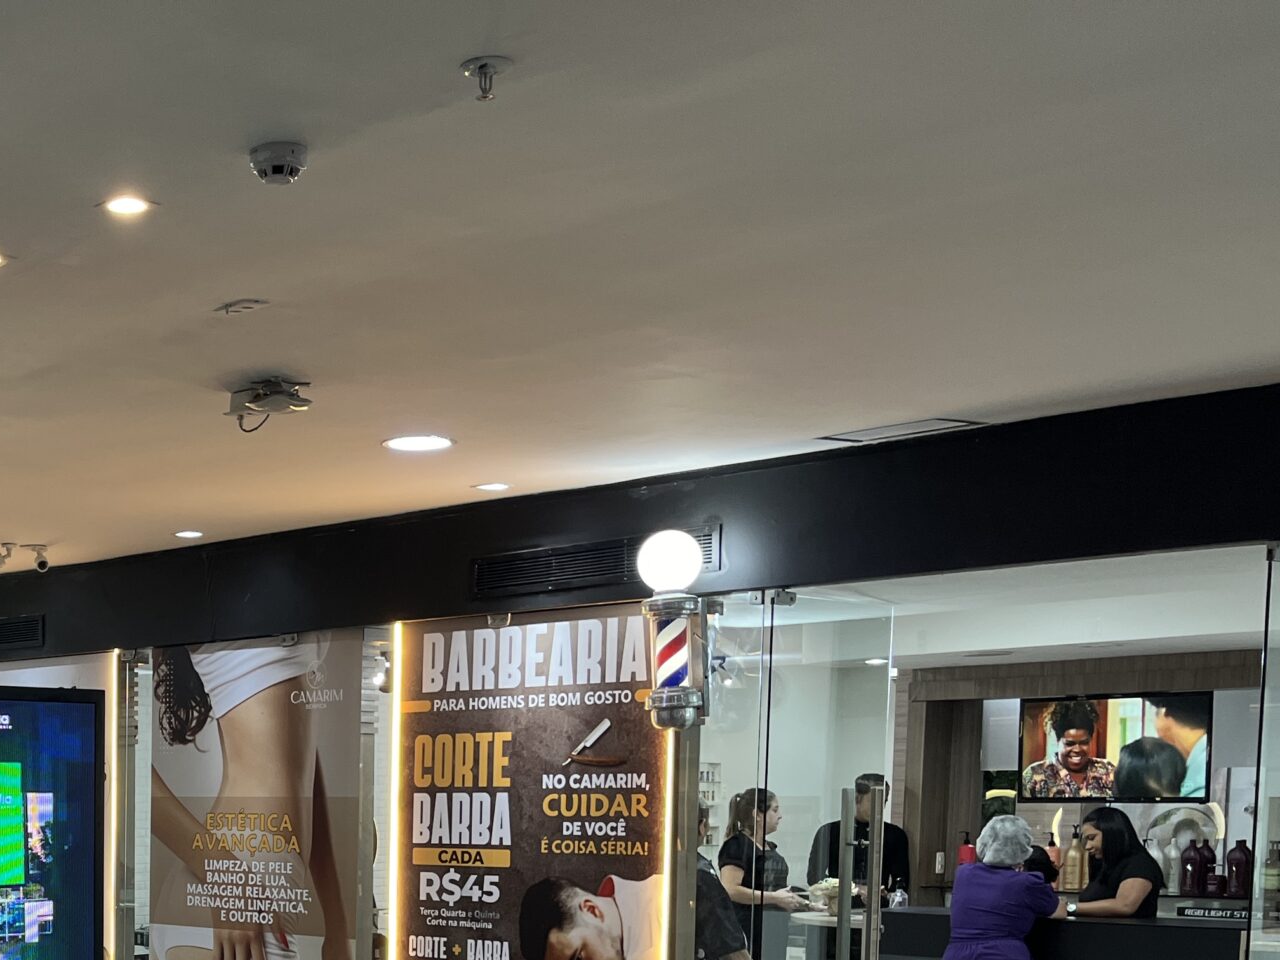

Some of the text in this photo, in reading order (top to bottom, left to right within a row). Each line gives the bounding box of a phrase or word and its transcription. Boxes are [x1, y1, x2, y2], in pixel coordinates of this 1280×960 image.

[422, 615, 648, 693] BARBEARIA
[290, 688, 343, 704] CAMARIM
[433, 690, 632, 712] PARA HOMENS DE BOM GOSTO
[414, 731, 512, 788] CORTE
[542, 773, 650, 791] NO CAMARIM,
[542, 793, 649, 817] CUIDAR
[206, 809, 293, 832] ESTÉTICA
[412, 792, 512, 846] BARBA
[562, 819, 626, 837] DE VOCÊ
[192, 833, 301, 858] AVANÇADA
[541, 838, 649, 856] É COISA SÉRIA!
[437, 849, 484, 865] CADA
[204, 859, 293, 874] LIMPEZA DE PELE
[206, 872, 245, 885] BANHO
[248, 873, 263, 885] DE
[419, 868, 501, 906] R$45
[186, 883, 312, 903] MASSAGEM RELAXANTE,
[186, 895, 245, 909] DRENAGEM
[220, 910, 274, 925] E OUTROS
[419, 907, 439, 917] Terça
[440, 908, 466, 919] Quarta
[474, 910, 500, 920] Quinta
[1184, 908, 1204, 917] RGB
[1205, 909, 1231, 918] LIGHT
[426, 917, 492, 931] Corte na máquina
[408, 934, 448, 960] CORTE
